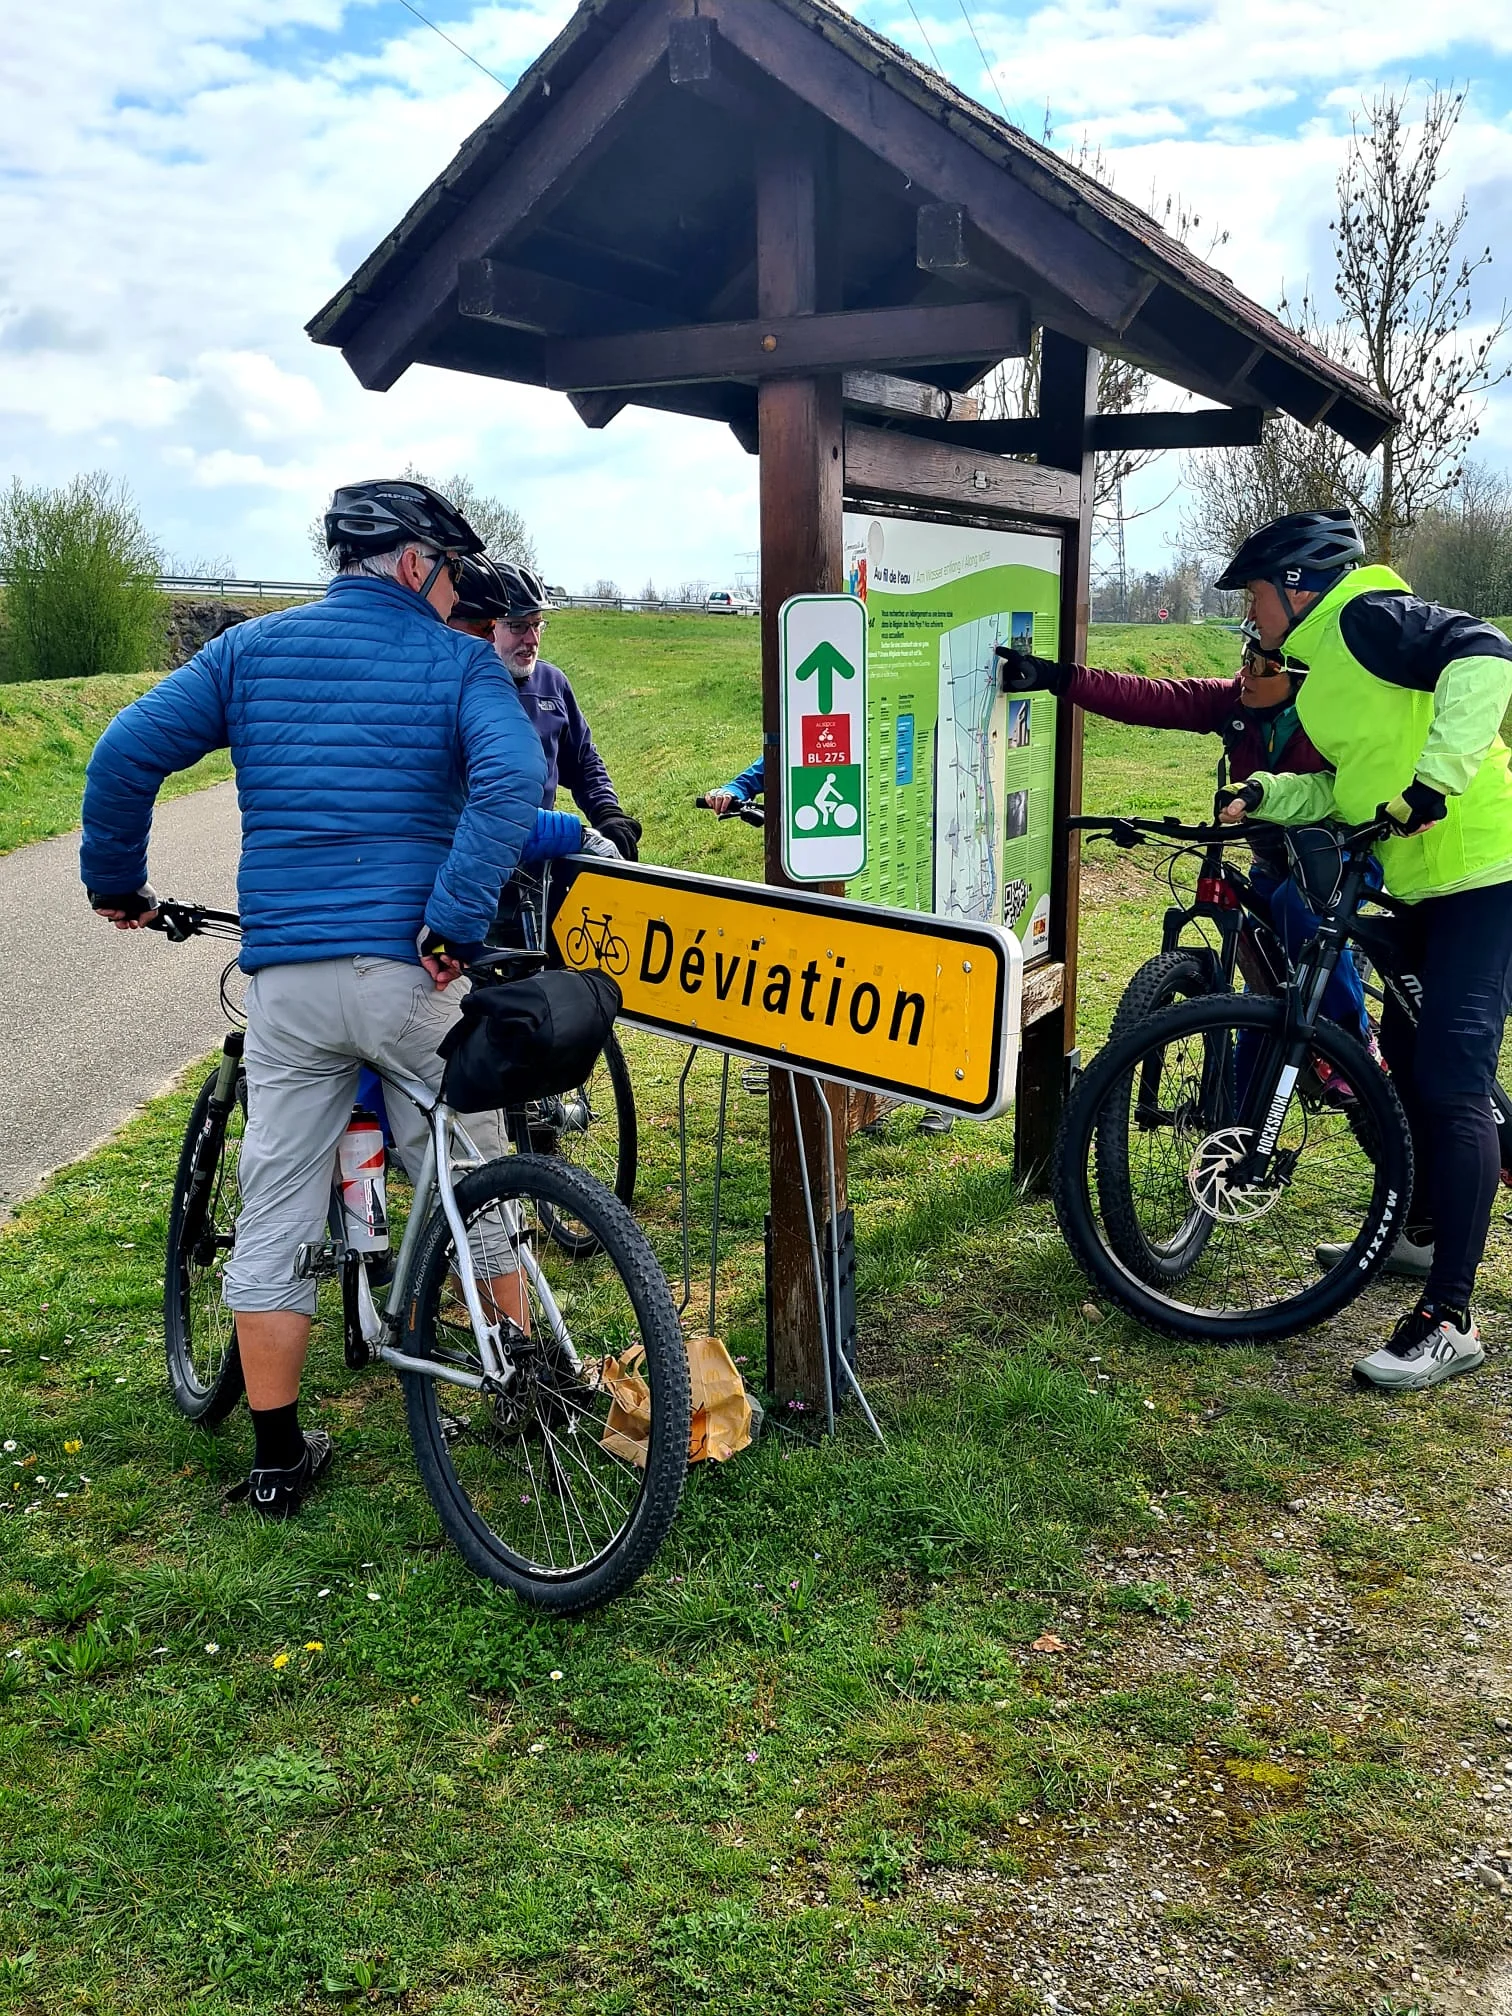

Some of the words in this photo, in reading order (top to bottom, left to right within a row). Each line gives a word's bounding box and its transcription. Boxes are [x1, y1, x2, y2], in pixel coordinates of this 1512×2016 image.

[874, 566, 882, 580] Au
[889, 569, 897, 583] de
[897, 571, 911, 584] l'eau
[808, 753, 823, 763] BL
[824, 751, 846, 763] 275
[640, 918, 925, 1046] Déviation
[1256, 1095, 1289, 1156] ROCKSHOX
[1358, 1189, 1398, 1271] MAXXIS
